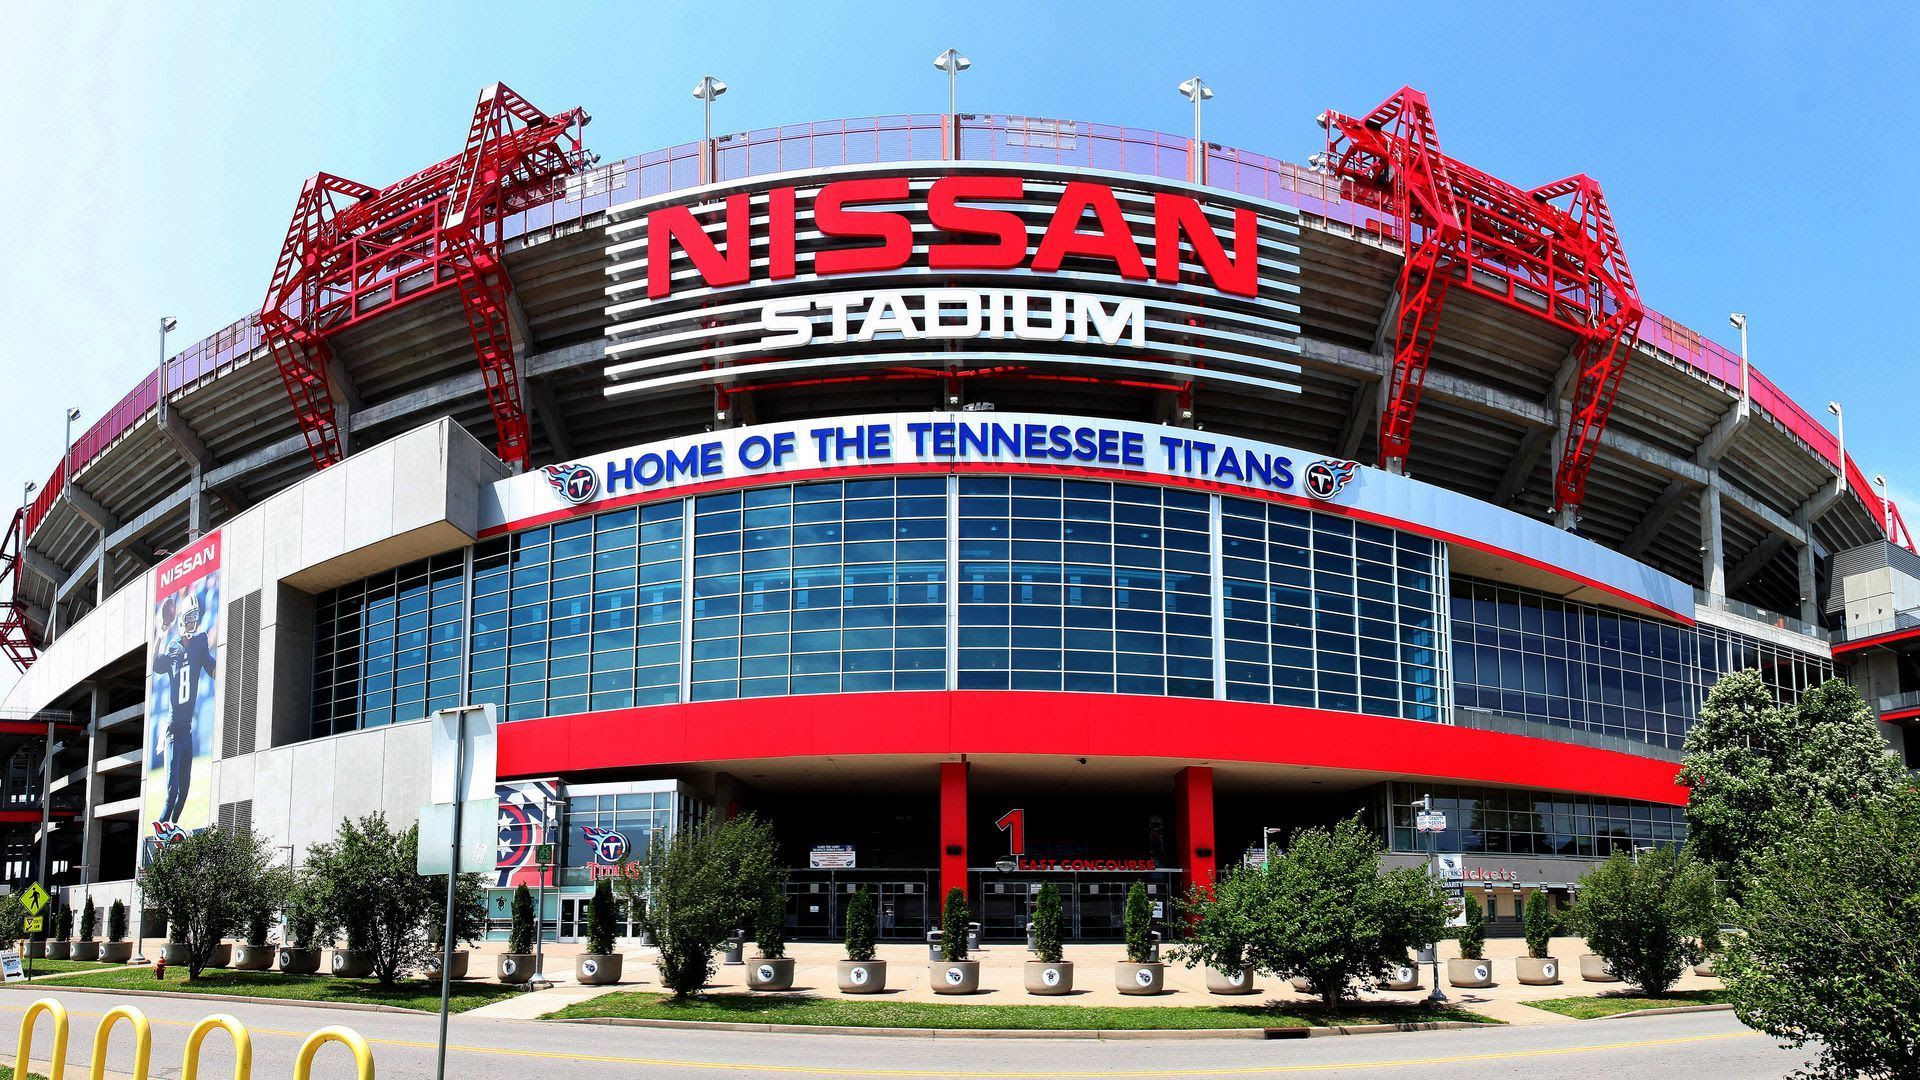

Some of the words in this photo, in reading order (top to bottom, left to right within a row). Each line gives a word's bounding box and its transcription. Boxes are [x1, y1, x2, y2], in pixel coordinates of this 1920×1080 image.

[646, 176, 1258, 299] NISSAN
[761, 289, 1146, 349] STADIUM
[606, 442, 723, 494] HOME
[740, 432, 795, 469] OF
[811, 424, 891, 461] THE
[908, 422, 1145, 466] TENNESSEE
[1160, 436, 1295, 489] TITANS
[160, 543, 215, 589] NISSAN
[178, 665, 191, 705] 8
[995, 809, 1024, 855] 1
[1018, 859, 1056, 871] EAST
[1060, 859, 1156, 871] CONCOURSE
[1441, 881, 1464, 889] CHARITY
[1462, 865, 1517, 880] ickets
